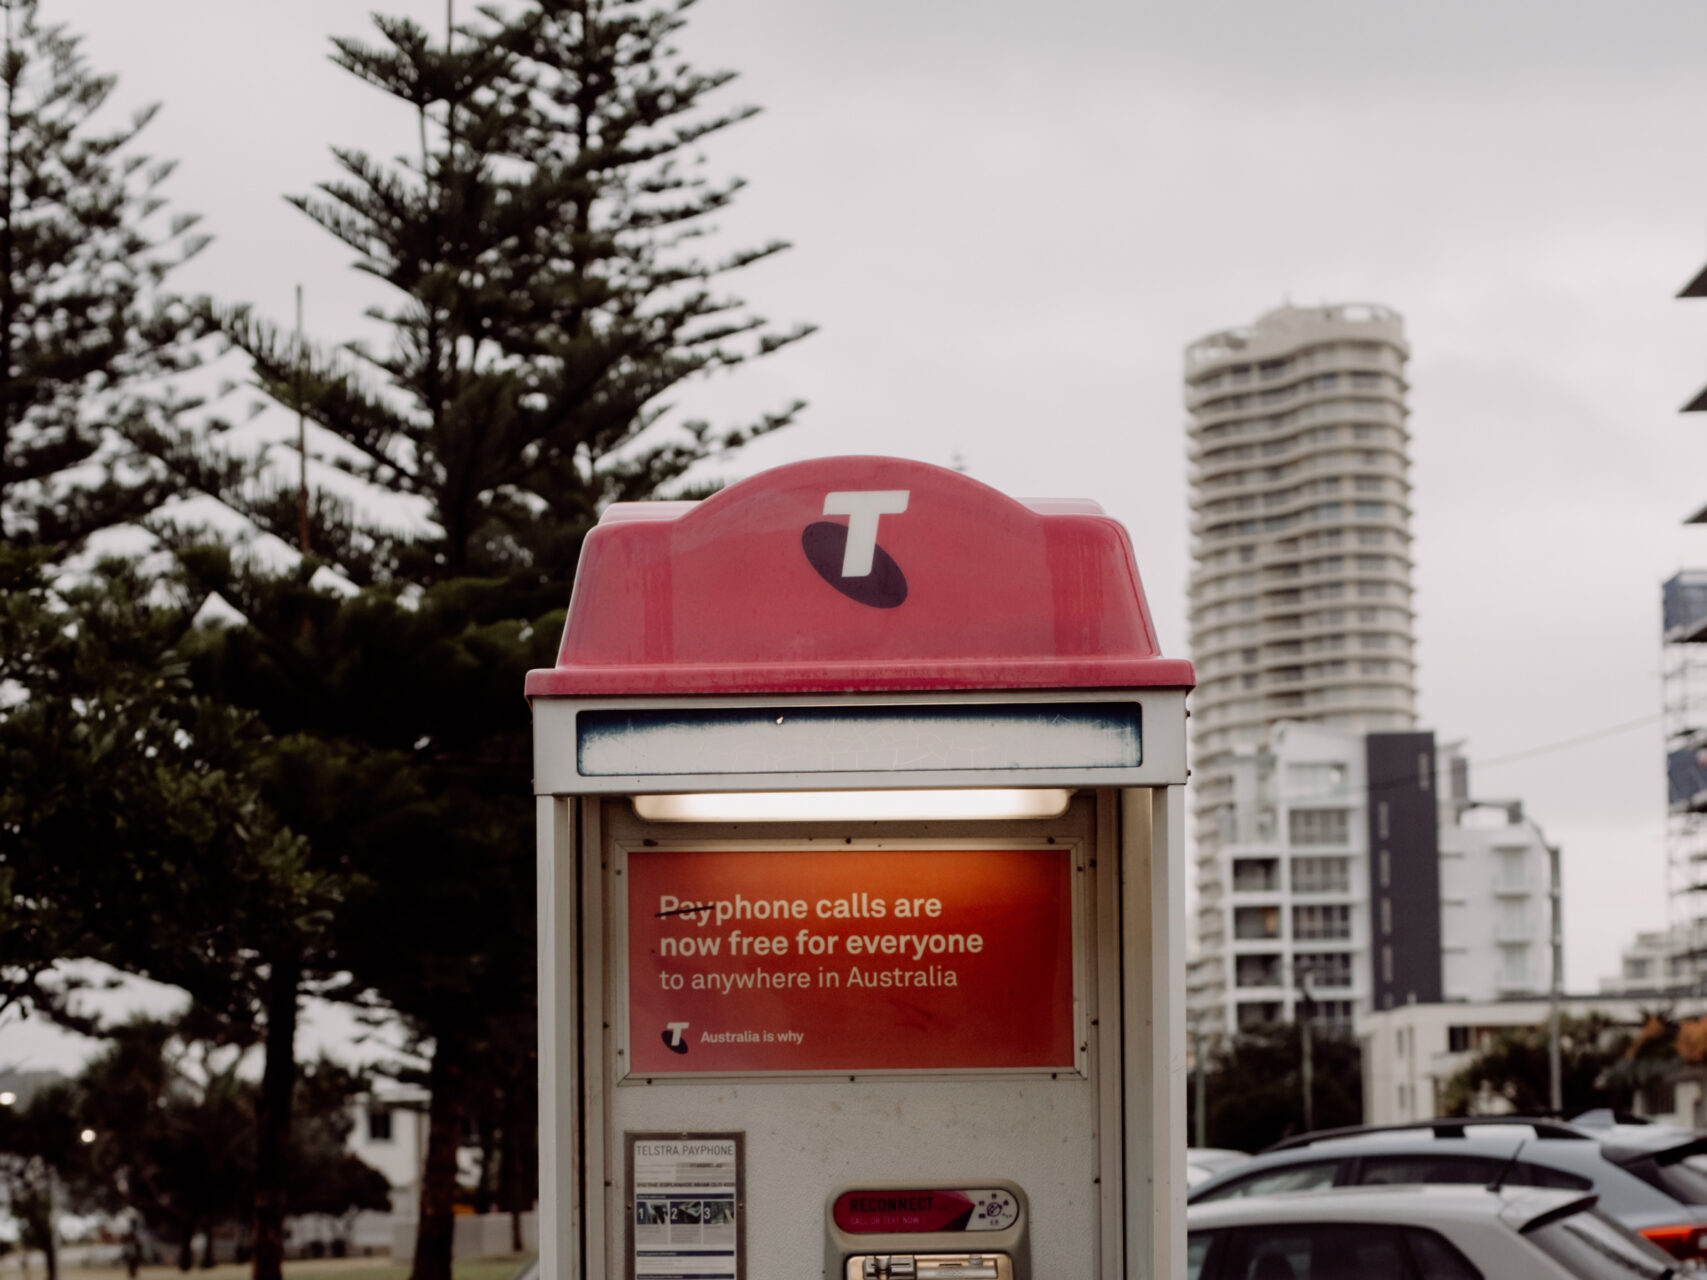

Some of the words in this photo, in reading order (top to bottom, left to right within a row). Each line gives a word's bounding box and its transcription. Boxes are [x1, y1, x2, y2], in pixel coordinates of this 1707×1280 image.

[823, 490, 910, 577] T
[659, 894, 808, 927] Payphone
[816, 892, 887, 919] calls
[894, 898, 942, 918] are
[660, 936, 721, 956] now
[728, 930, 789, 956] free
[795, 929, 839, 955] for
[846, 933, 984, 960] everyone
[659, 970, 684, 990] to
[691, 967, 811, 994] anywhere
[818, 967, 840, 988] in
[846, 965, 957, 987] Australia
[666, 1022, 690, 1046] T
[701, 1030, 760, 1043] Australia
[763, 1030, 775, 1042] is
[777, 1030, 804, 1045] why
[637, 1145, 679, 1156] TELSTRA
[682, 1144, 734, 1155] PAYPHONE
[638, 1207, 644, 1220] 1
[671, 1207, 678, 1220] 2
[704, 1207, 711, 1219] 3
[850, 1216, 868, 1225] CALL
[883, 1216, 899, 1224] TEXT
[902, 1216, 919, 1224] NOW
